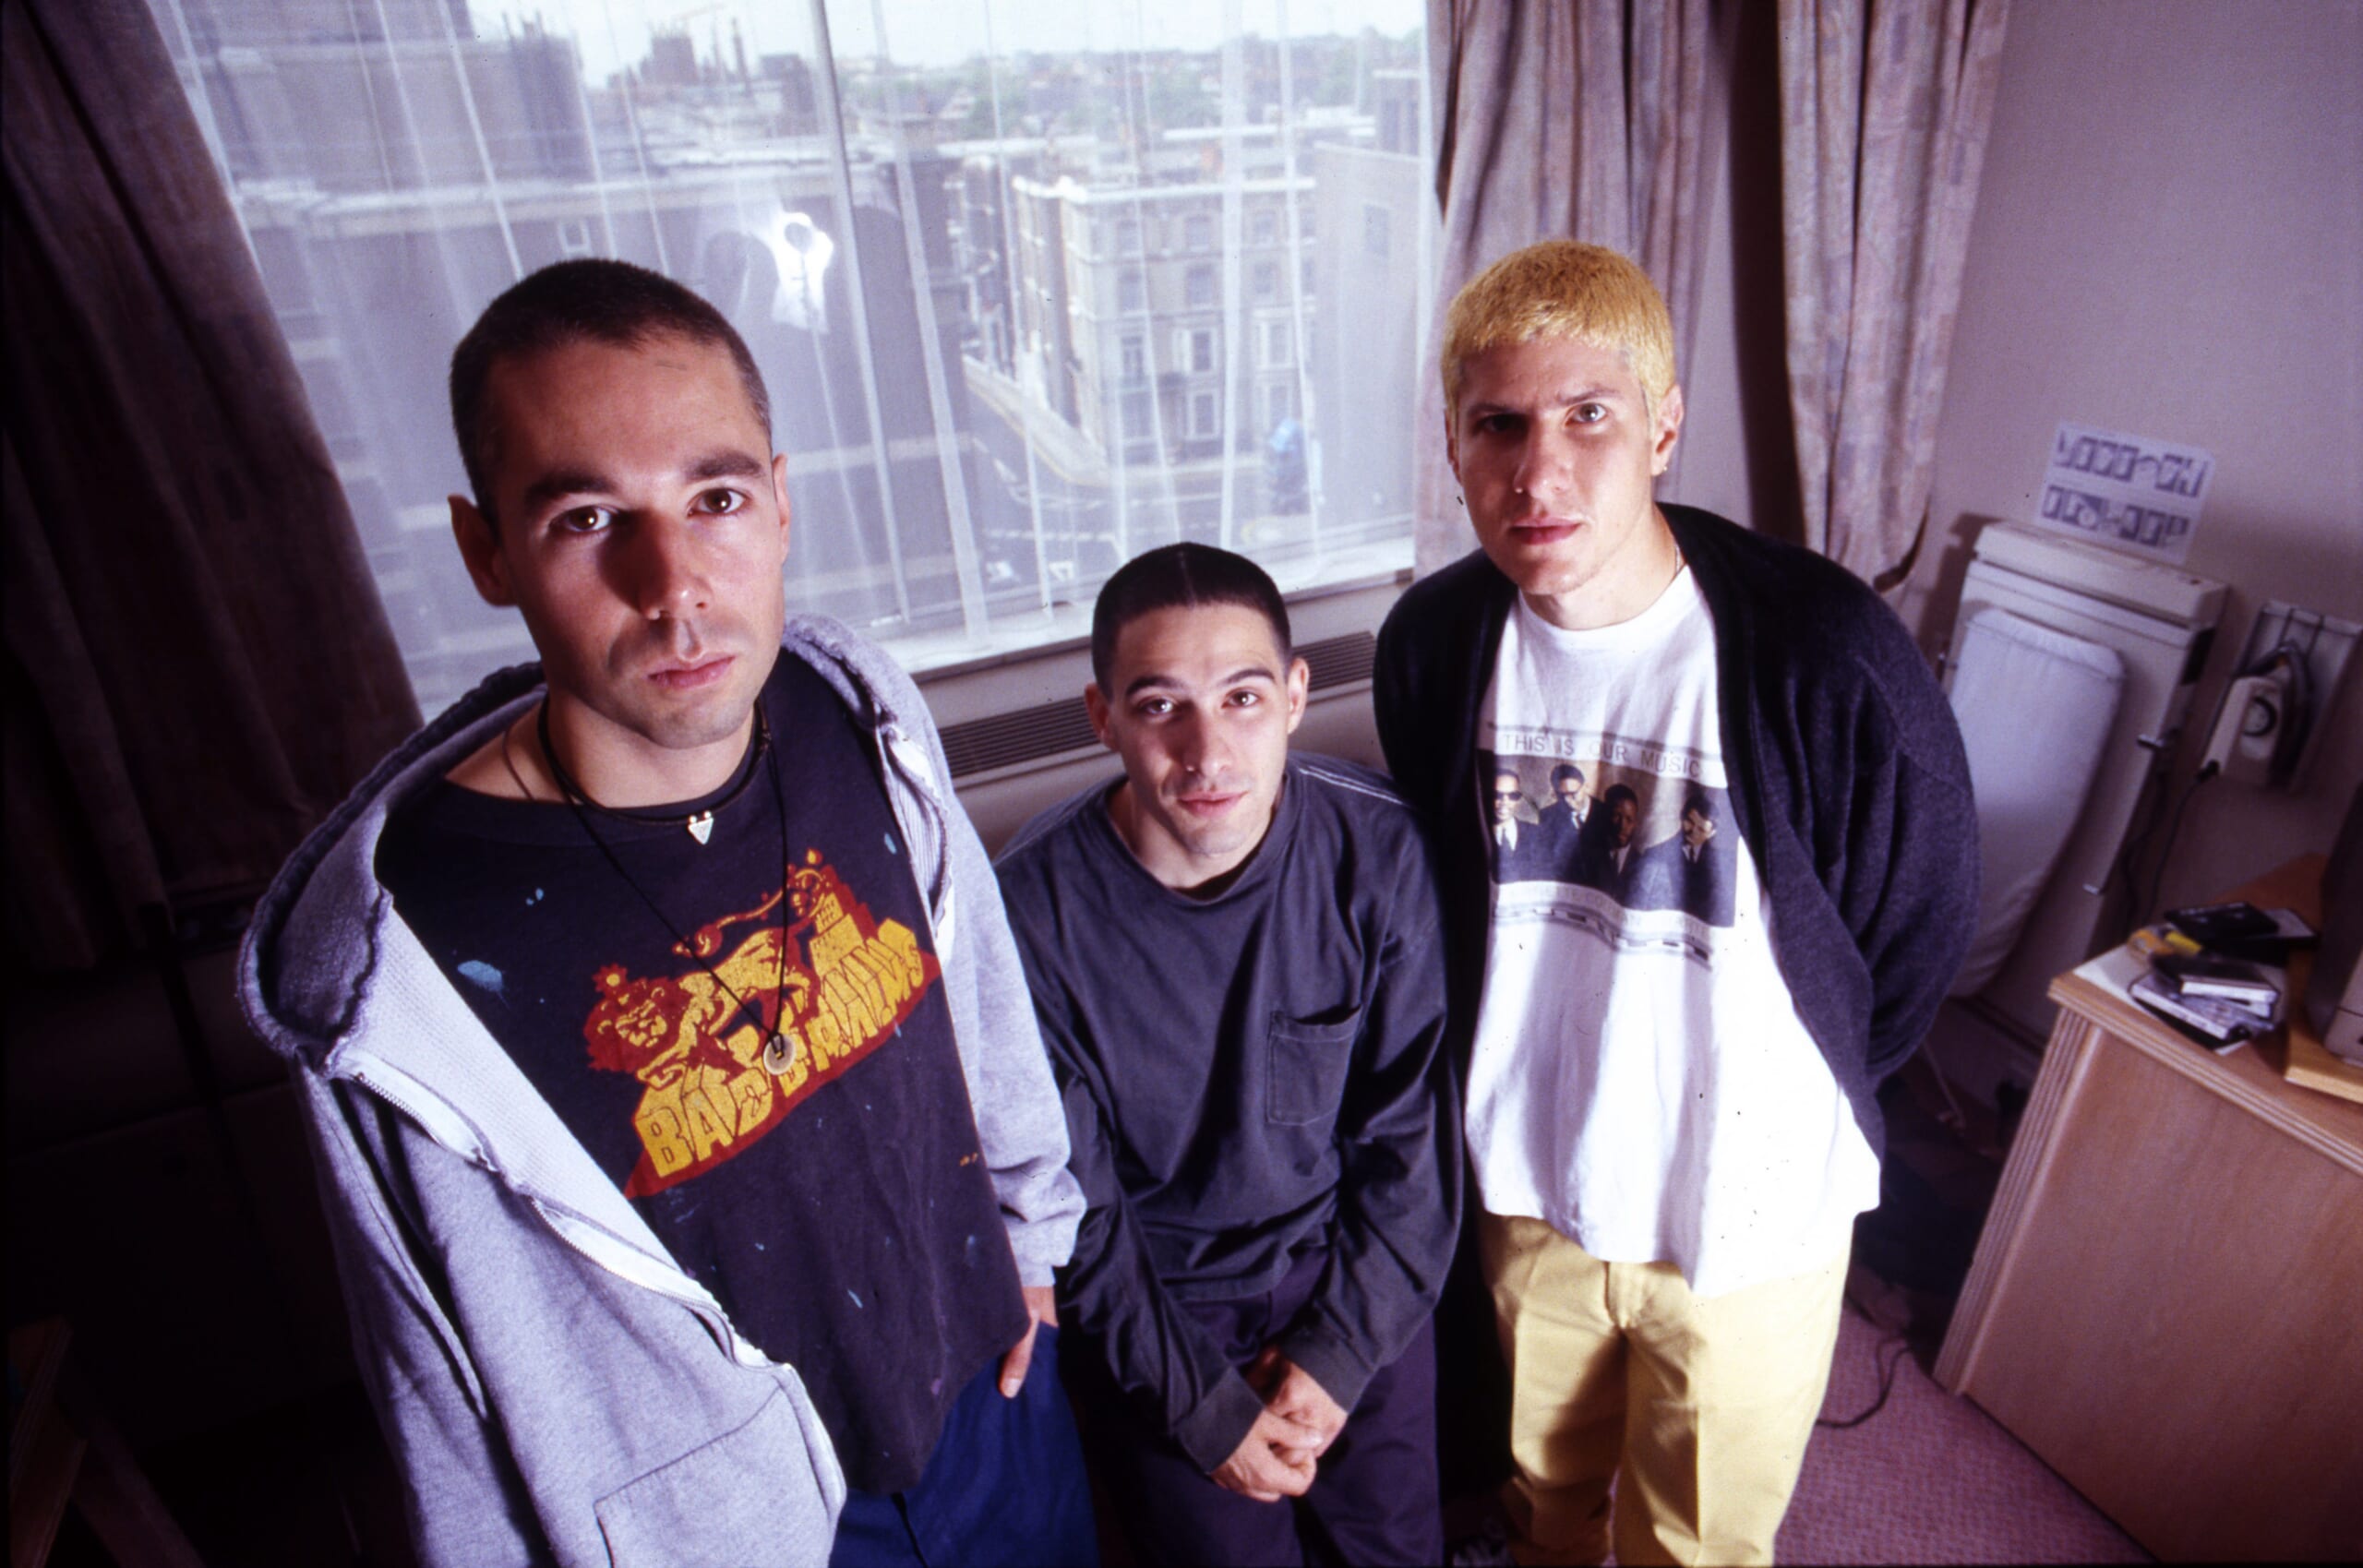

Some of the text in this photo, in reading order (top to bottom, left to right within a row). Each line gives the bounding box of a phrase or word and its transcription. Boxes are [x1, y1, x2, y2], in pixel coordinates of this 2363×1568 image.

[1504, 734, 1700, 778] THIS IS OUR MUSIC
[633, 1052, 774, 1179] BAD
